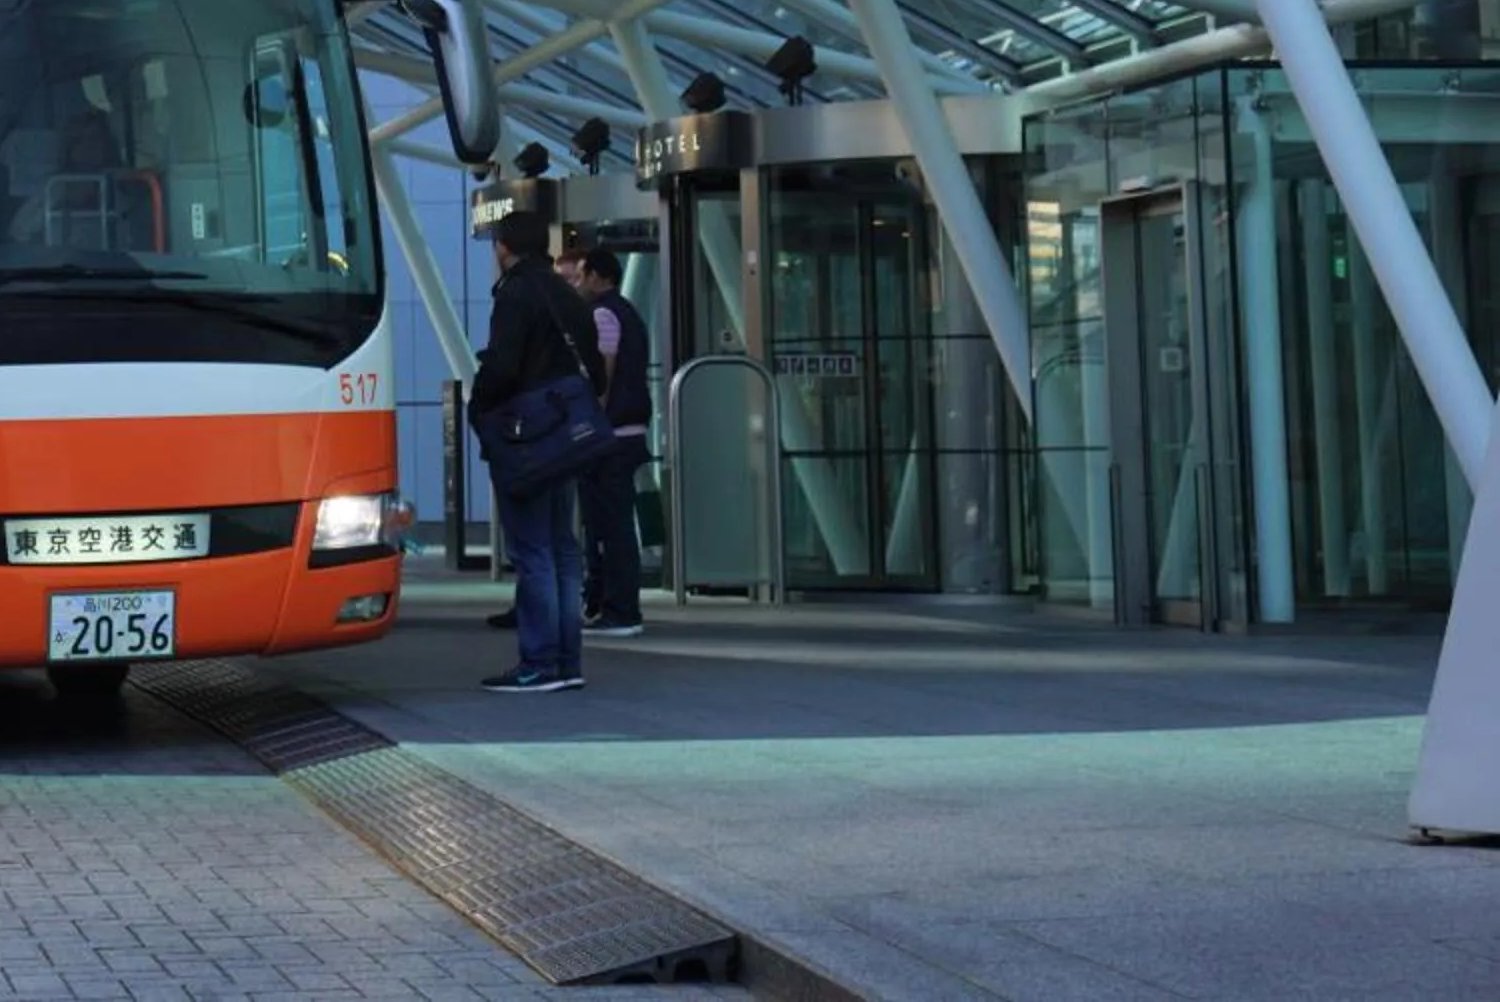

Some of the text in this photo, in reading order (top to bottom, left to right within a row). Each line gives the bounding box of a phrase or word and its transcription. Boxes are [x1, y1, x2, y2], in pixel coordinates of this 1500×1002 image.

[340, 373, 377, 406] 517
[13, 523, 197, 556] 東京空港交通
[71, 613, 169, 655] 20-56
